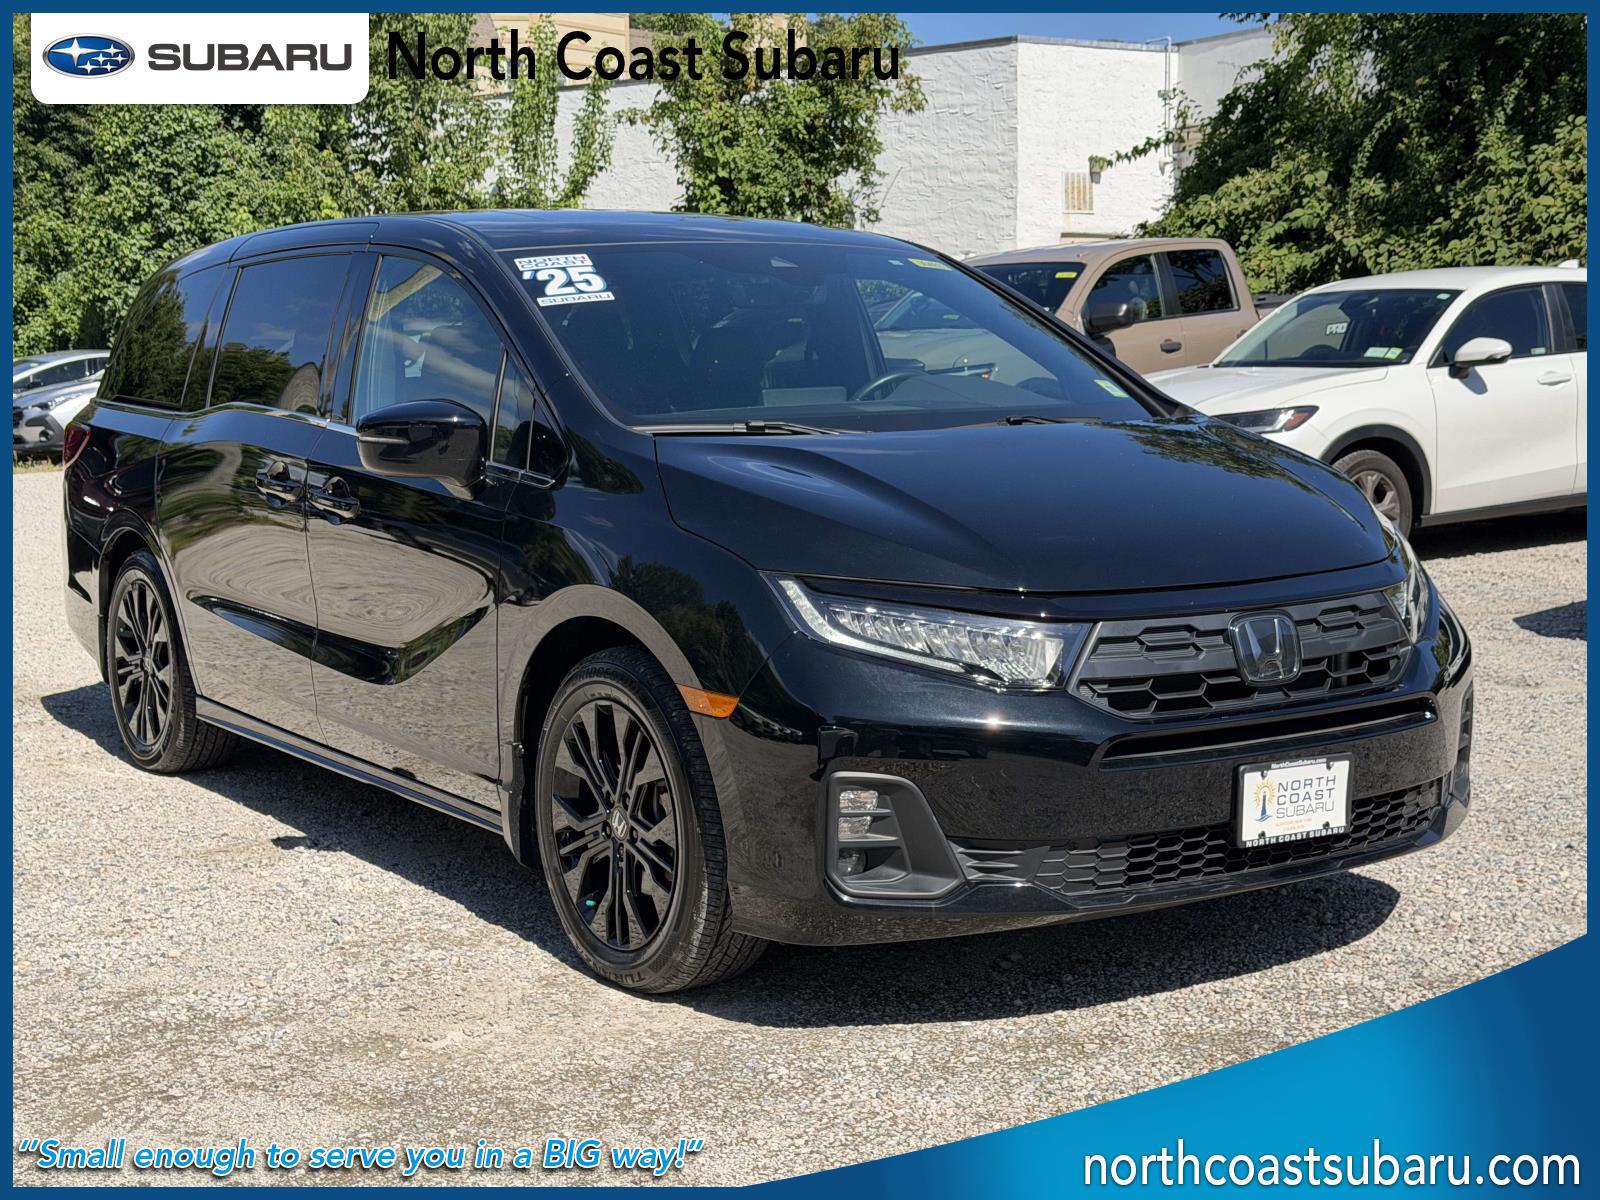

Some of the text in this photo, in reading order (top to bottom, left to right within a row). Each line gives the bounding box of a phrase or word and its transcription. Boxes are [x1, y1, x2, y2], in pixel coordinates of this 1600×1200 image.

[518, 255, 586, 265] NORTH
[520, 260, 588, 269] COAST
[522, 266, 608, 297] '25
[540, 293, 611, 305] SUBARU
[1277, 775, 1337, 793] NORTH
[1276, 788, 1336, 806] COAST
[1275, 800, 1335, 819] SUBARU
[1245, 837, 1277, 848] NORTH
[1278, 830, 1308, 843] COAST
[1309, 826, 1345, 839] SUBARU
